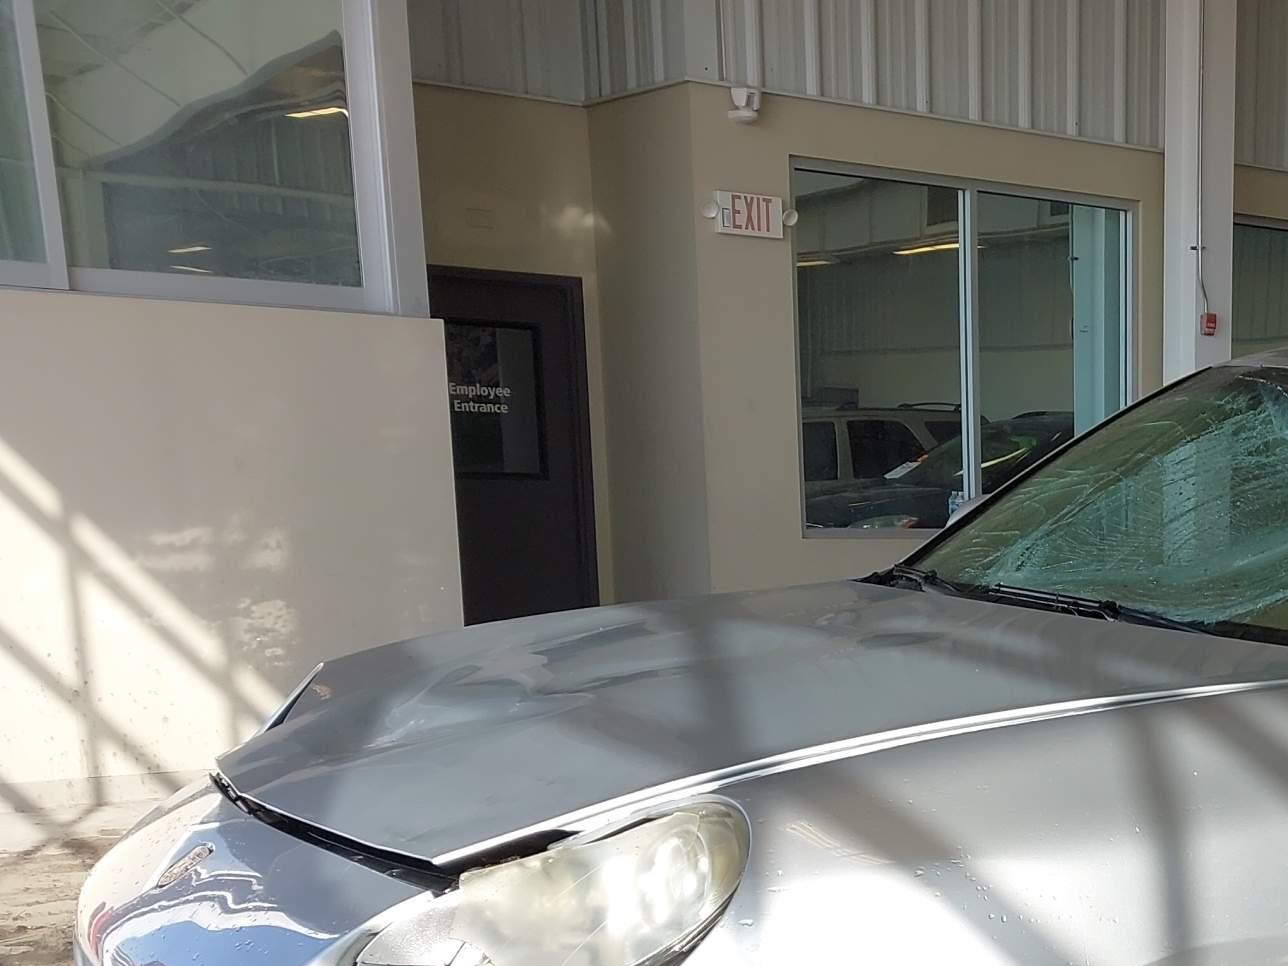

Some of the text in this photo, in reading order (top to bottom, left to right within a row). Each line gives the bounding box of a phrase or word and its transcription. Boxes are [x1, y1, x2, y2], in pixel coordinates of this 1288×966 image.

[731, 194, 772, 232] EXIT
[449, 382, 511, 399] Employee
[454, 400, 509, 414] Entrance
